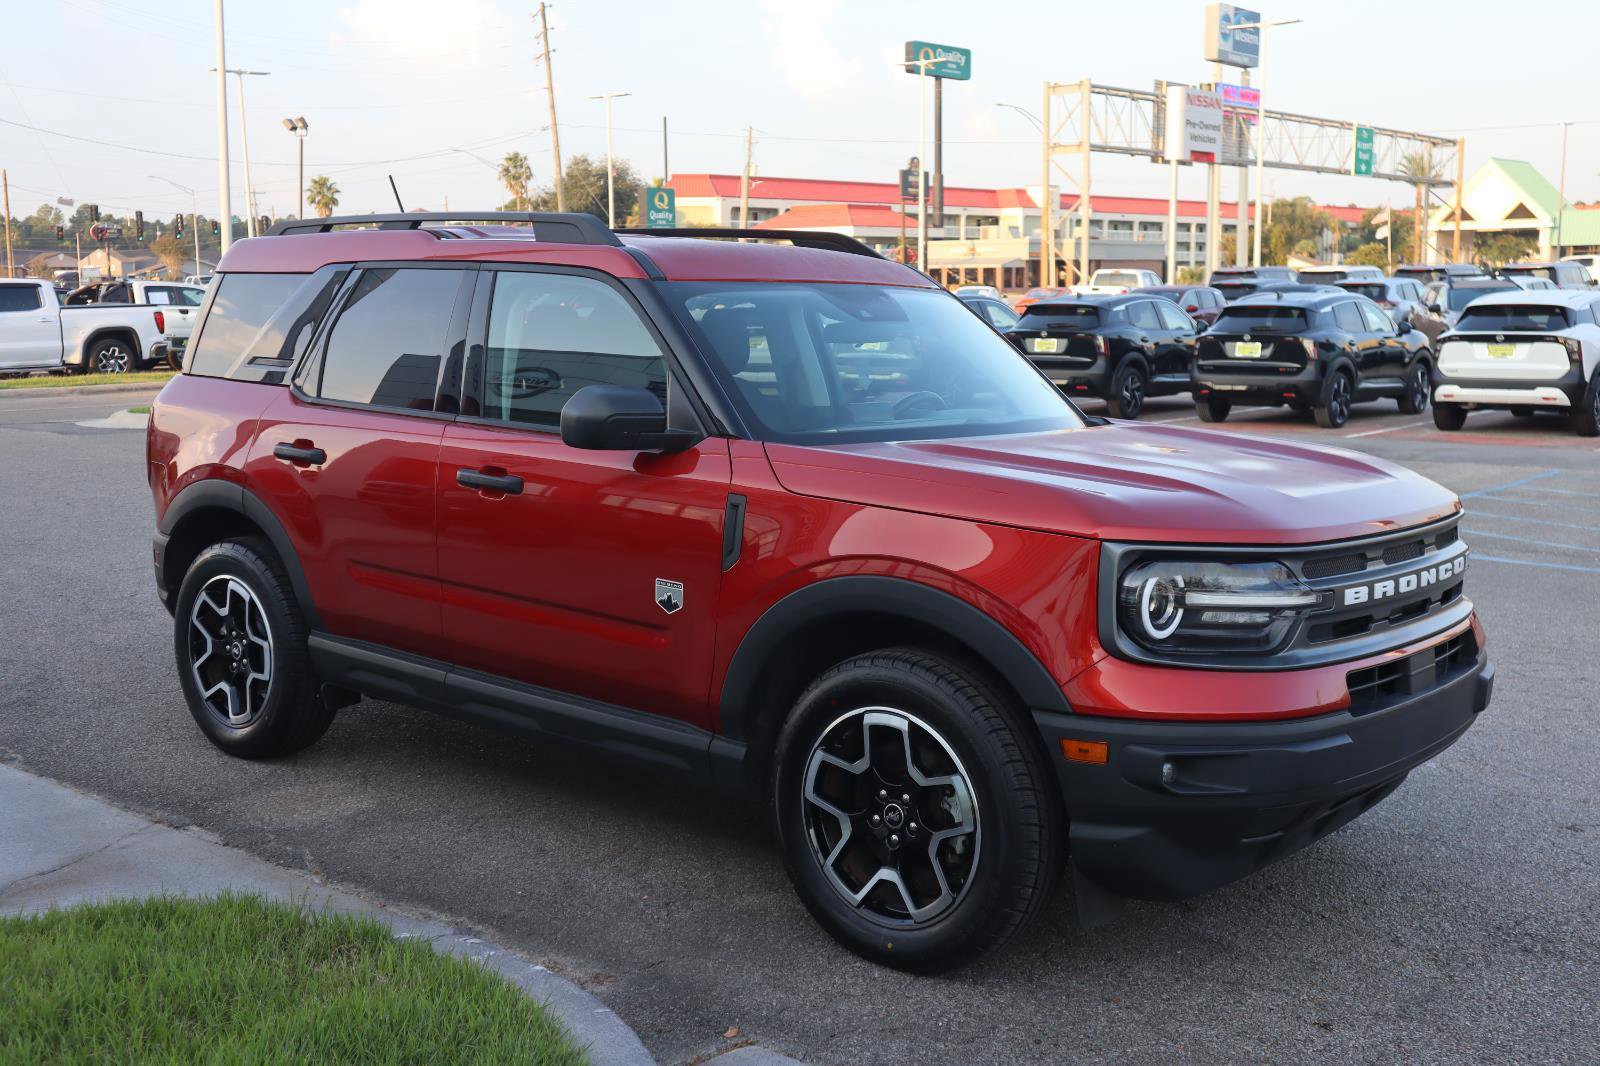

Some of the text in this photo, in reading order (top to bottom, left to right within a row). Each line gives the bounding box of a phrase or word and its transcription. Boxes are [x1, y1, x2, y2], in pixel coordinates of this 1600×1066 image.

[1187, 93, 1222, 110] NISSAN
[1185, 119, 1221, 132] Pre-Owned
[1190, 133, 1216, 144] Vehicles
[654, 191, 669, 210] Q
[649, 210, 673, 221] Quality
[1344, 557, 1465, 605] BRONCO
